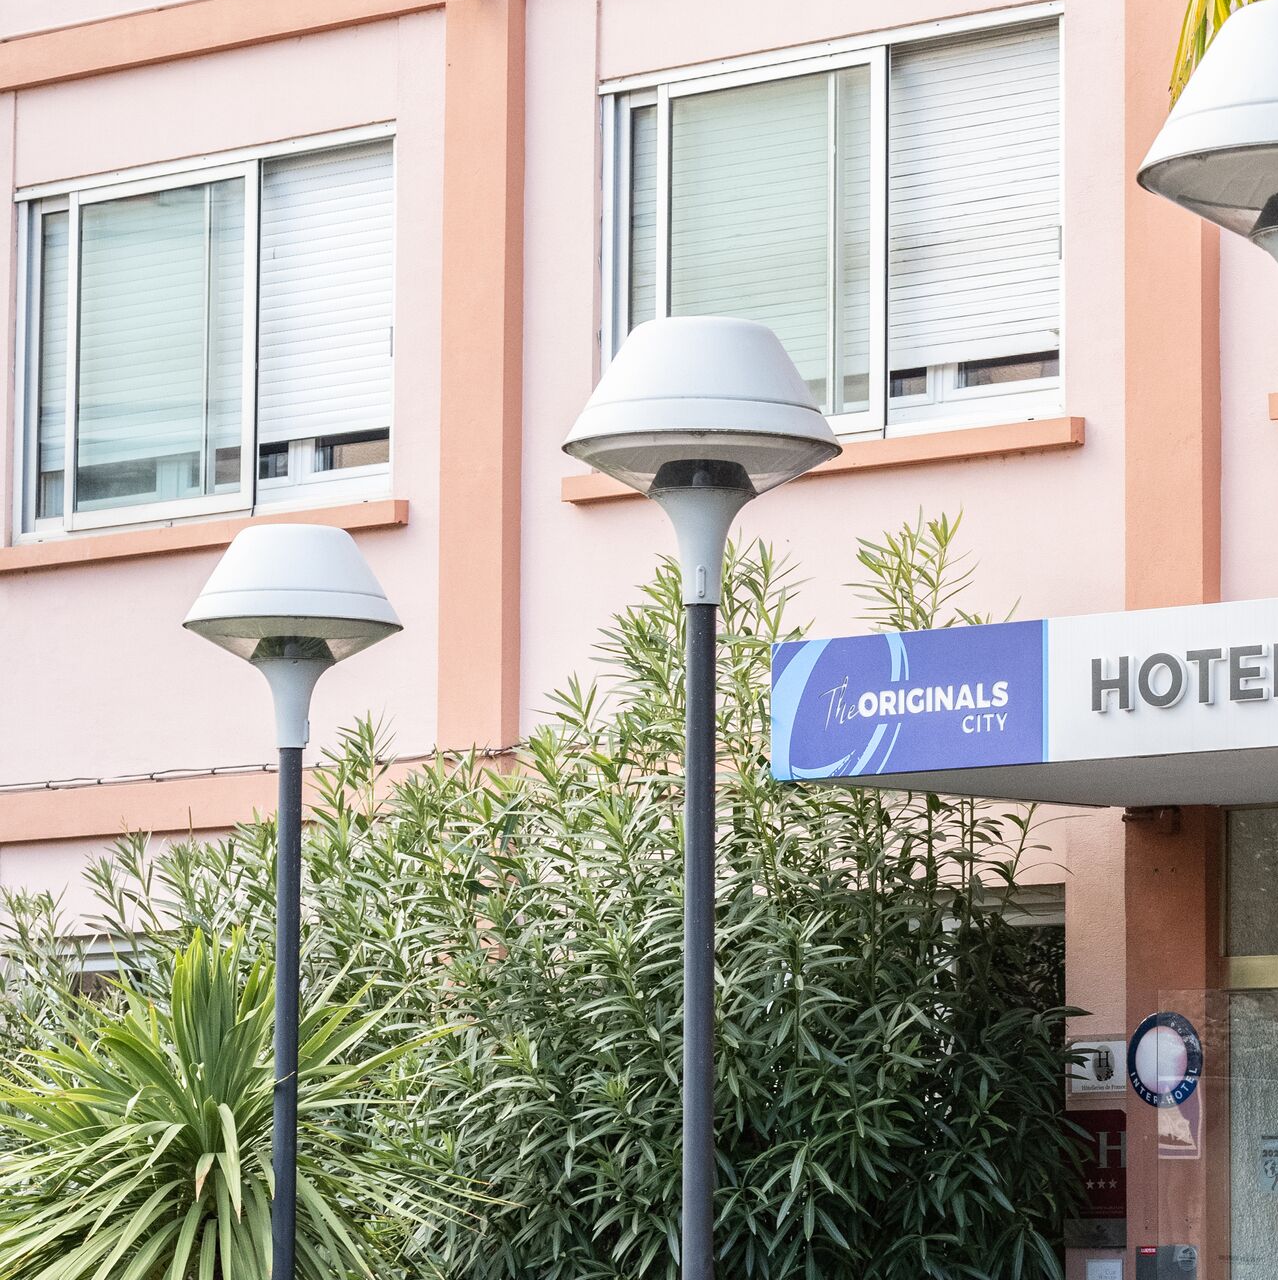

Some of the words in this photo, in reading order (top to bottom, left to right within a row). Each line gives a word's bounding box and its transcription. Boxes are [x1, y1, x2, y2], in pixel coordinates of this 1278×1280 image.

[819, 675, 861, 732] The
[858, 680, 1010, 719] ORIGINALS
[961, 712, 1009, 735] CITY
[1130, 1067, 1198, 1105] INTER-HOTEL
